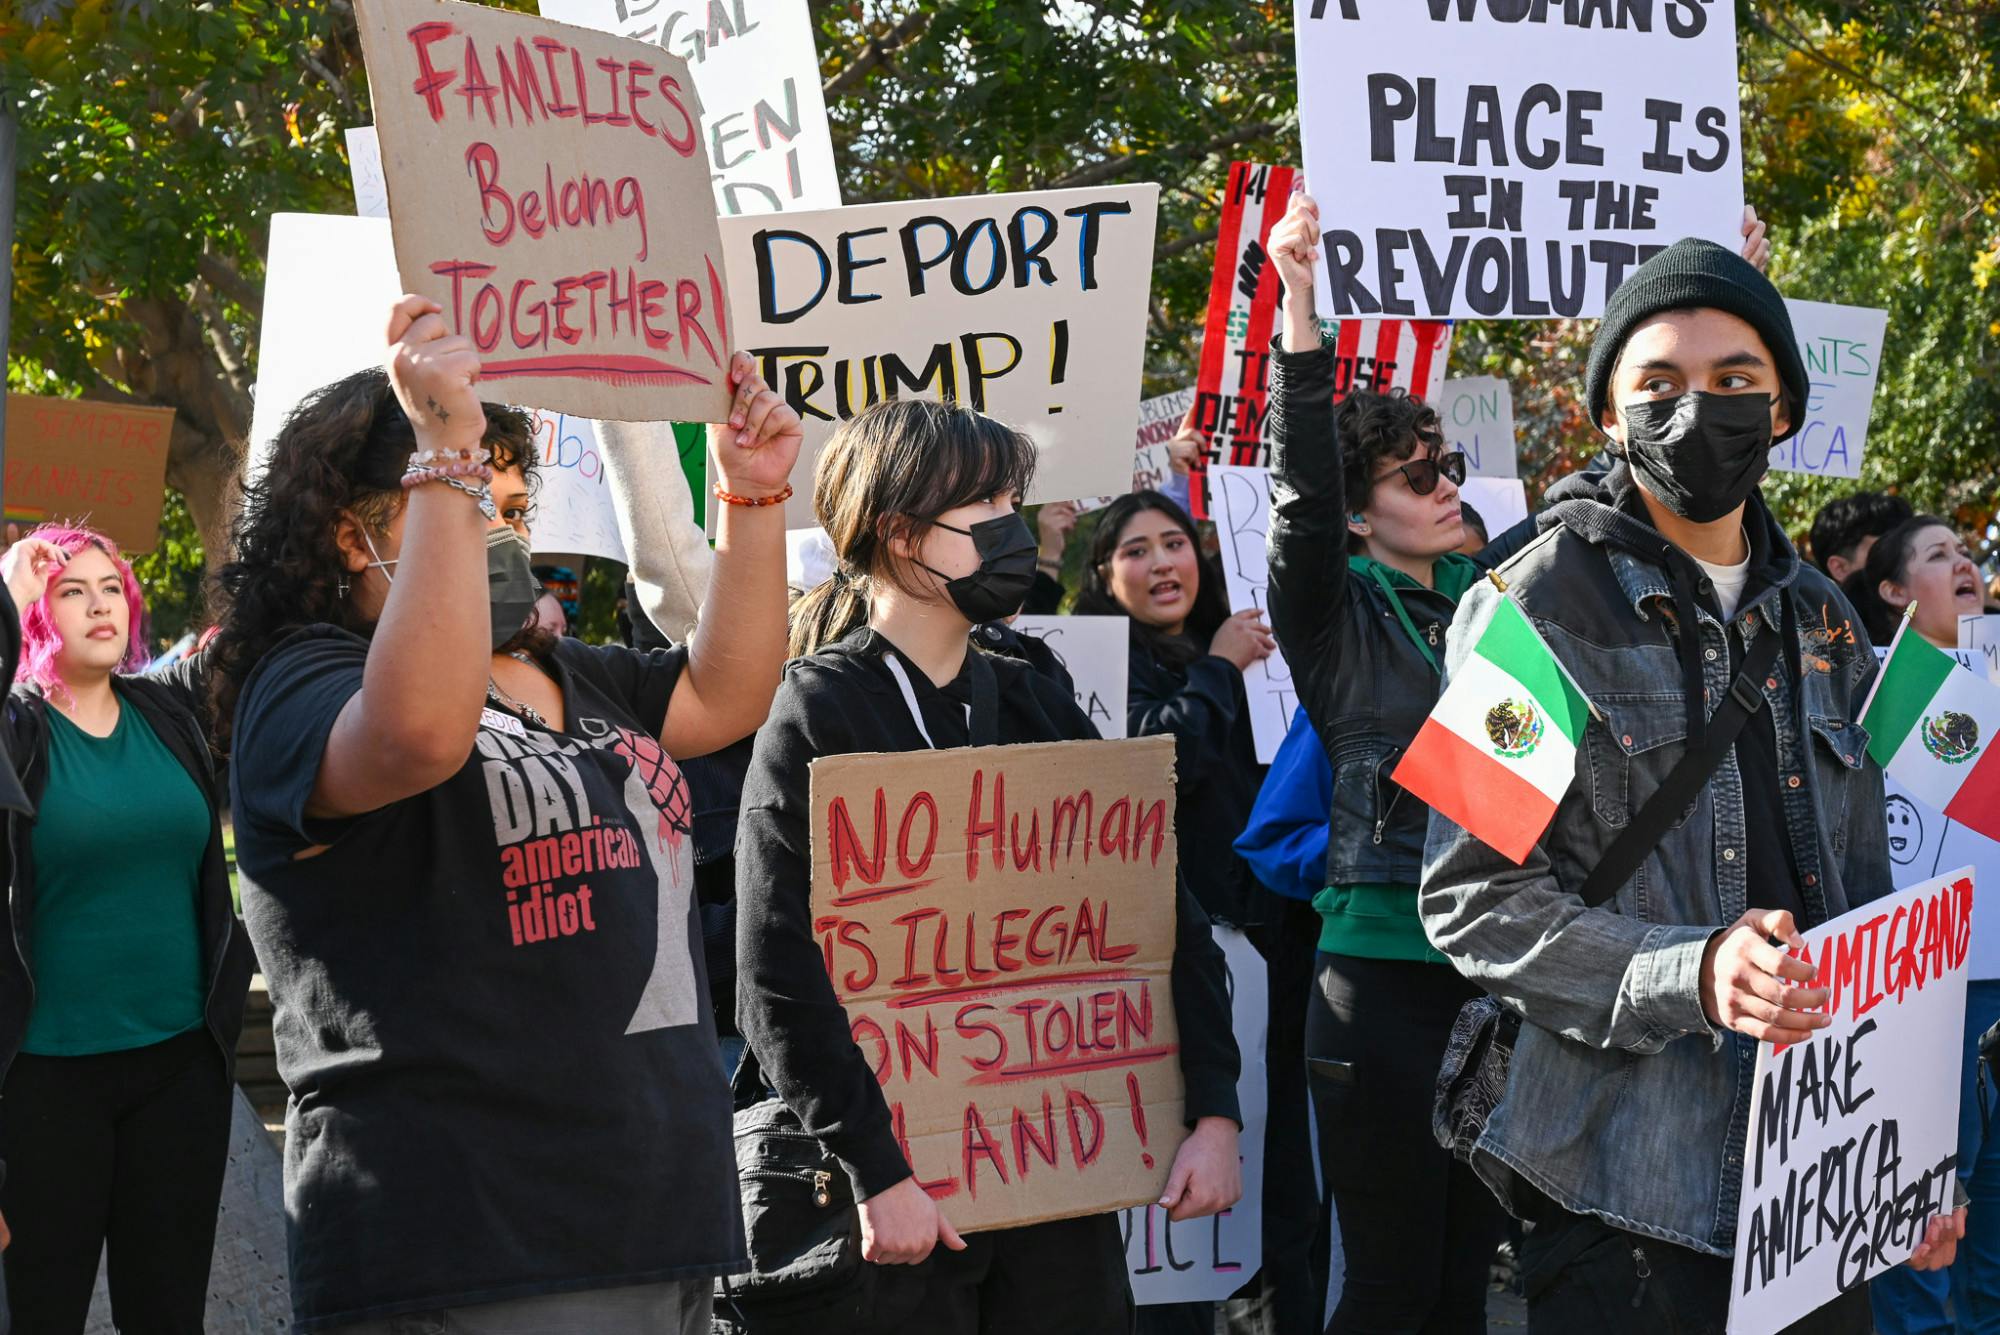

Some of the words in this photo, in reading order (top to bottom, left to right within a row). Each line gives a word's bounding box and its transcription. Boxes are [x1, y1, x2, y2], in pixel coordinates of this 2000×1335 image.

[406, 21, 697, 158] FAMILIES
[1366, 72, 1605, 170] PLACE
[1642, 98, 1731, 174] IS
[1443, 175, 1523, 232] IN
[1558, 180, 1659, 231] THE
[428, 252, 729, 369] TOGETHER!
[752, 200, 1132, 324] DEPORT
[1321, 227, 1668, 318] REVOLUT
[482, 754, 594, 847] DAY
[500, 814, 641, 890] american
[828, 786, 940, 895] NO
[965, 769, 1166, 882] Human
[506, 883, 597, 947] idiot
[814, 915, 880, 992] IS
[890, 896, 1142, 990] ILLEGAL
[850, 1008, 940, 1087] ON
[954, 981, 1154, 1072] STOLEN
[1753, 1018, 1878, 1193] MAKE
[1742, 1118, 1903, 1298] AMERICA
[1835, 1152, 1958, 1295] GREAT
